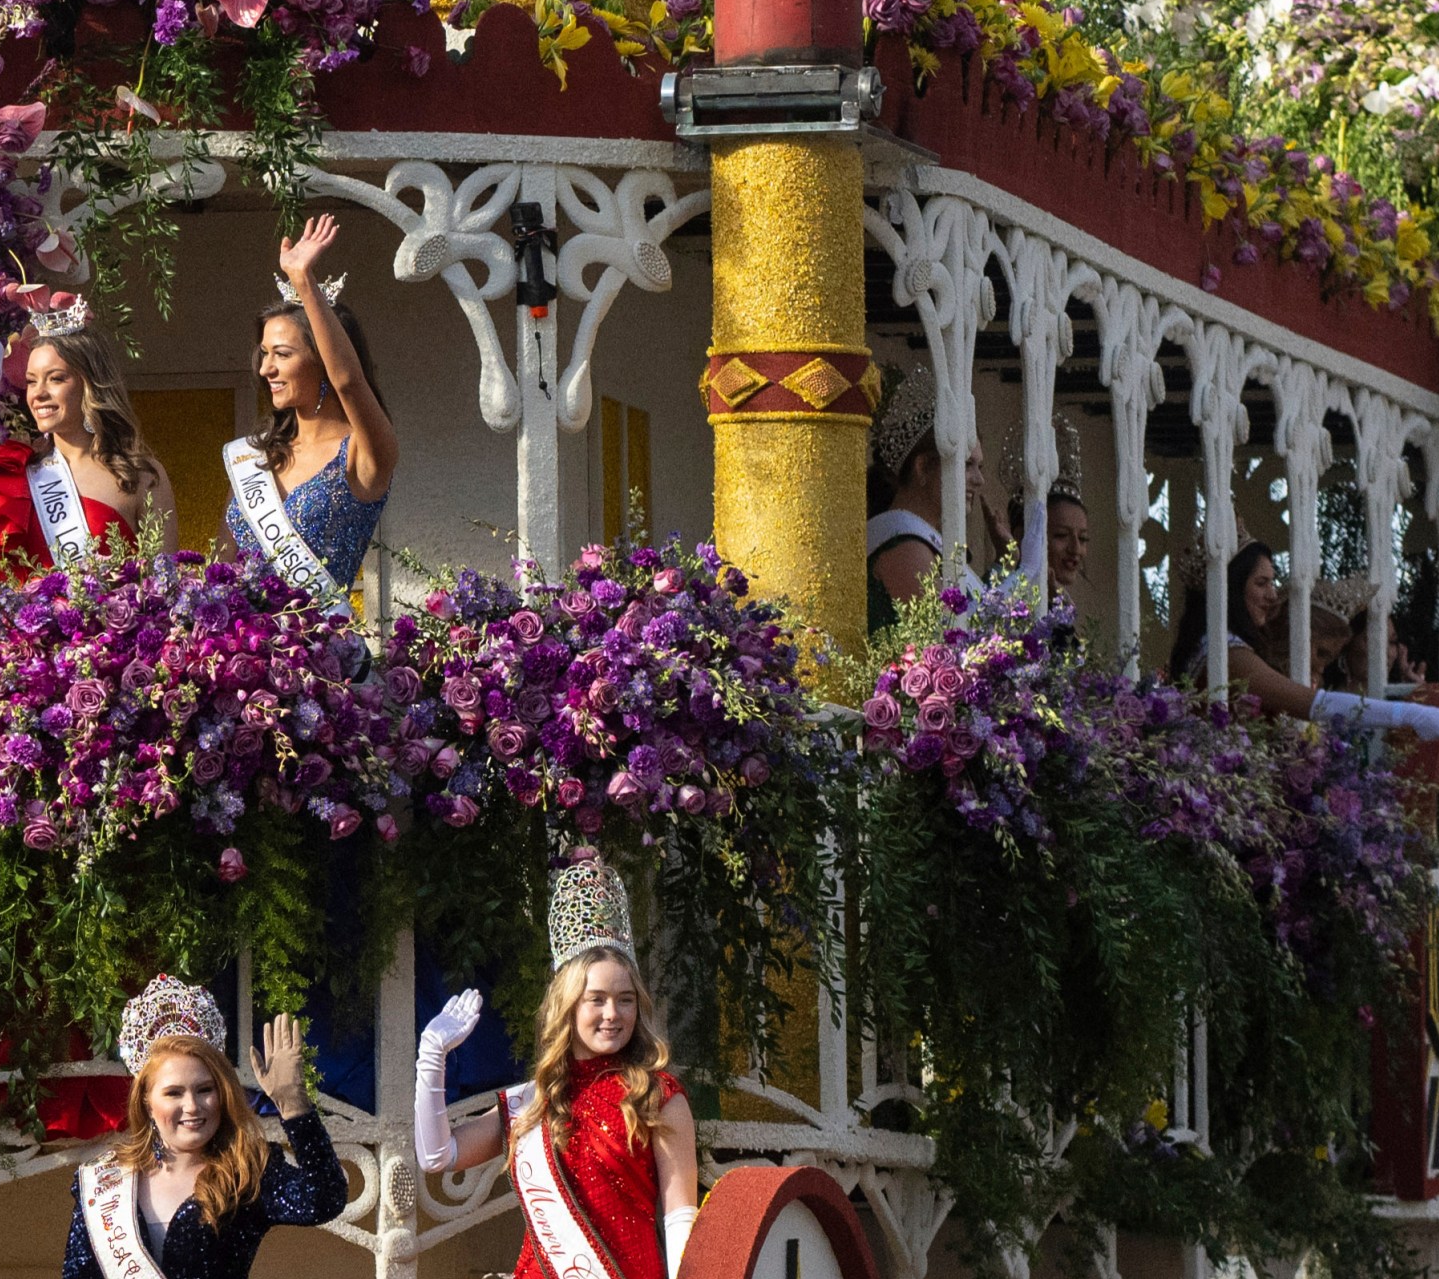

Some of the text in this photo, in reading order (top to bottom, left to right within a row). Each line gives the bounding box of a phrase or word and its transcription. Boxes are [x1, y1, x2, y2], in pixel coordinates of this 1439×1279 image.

[38, 480, 68, 523] Miss
[240, 472, 267, 509] Miss
[520, 1161, 566, 1258] Merry
